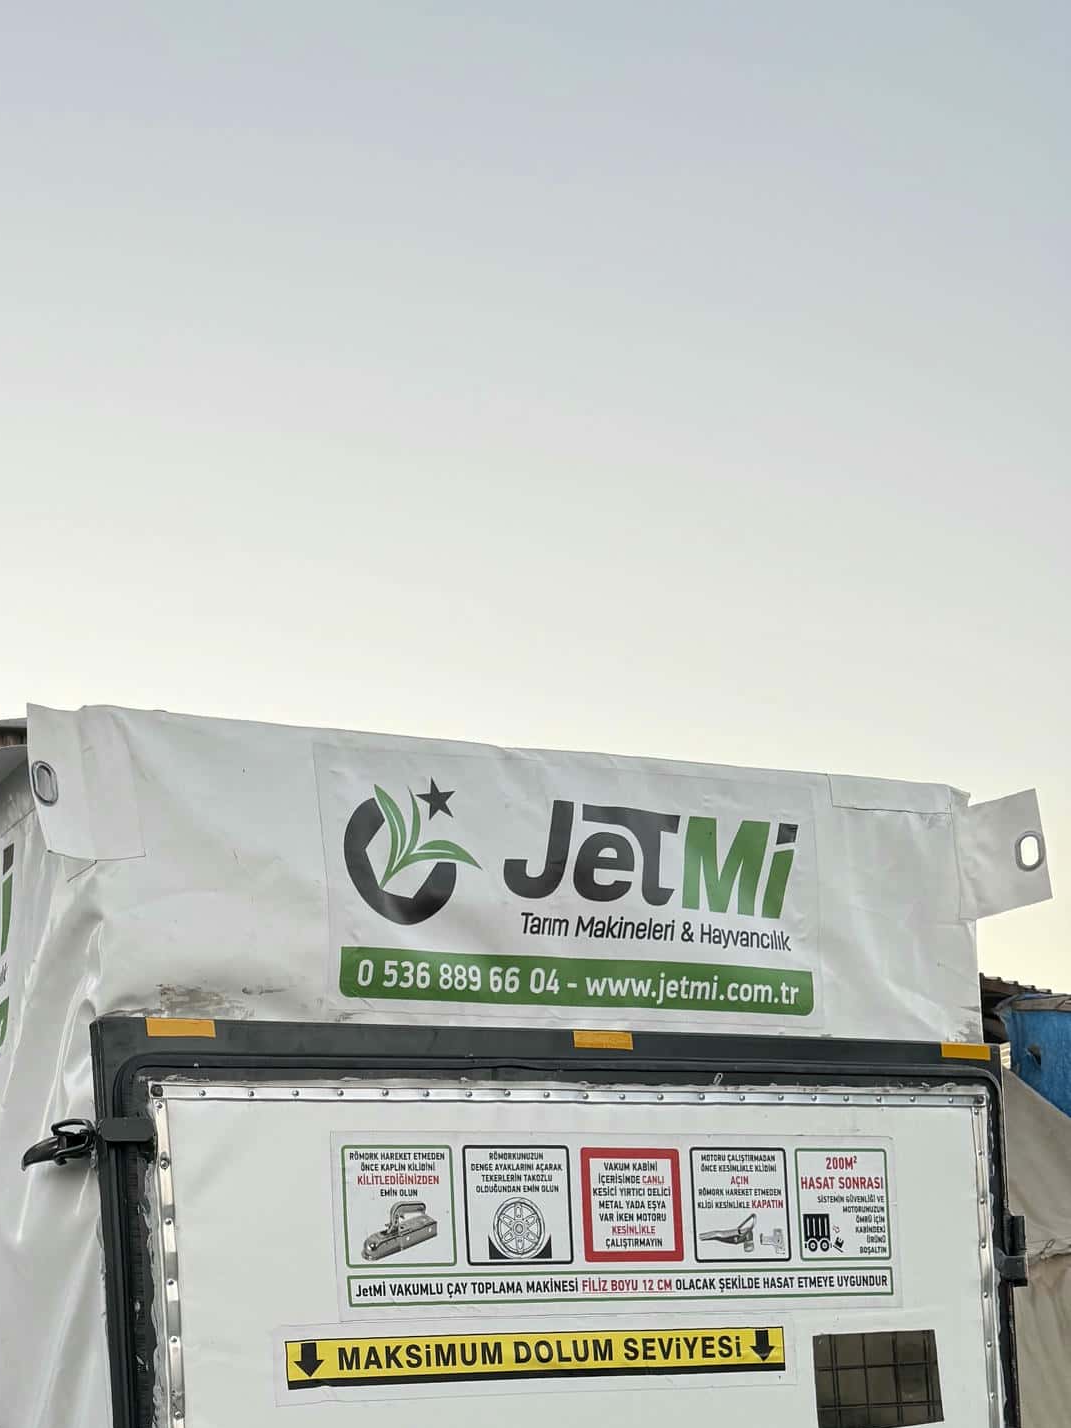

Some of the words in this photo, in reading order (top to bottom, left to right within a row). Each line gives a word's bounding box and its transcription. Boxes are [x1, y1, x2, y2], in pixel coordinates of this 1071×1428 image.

[521, 913, 568, 936] Tarım
[576, 915, 674, 942] Makineleri
[681, 923, 693, 942] &
[701, 924, 791, 950] Hayvancılık
[358, 960, 373, 986] 0
[383, 960, 430, 988] 536
[439, 963, 481, 991] 889
[490, 966, 519, 992] 66
[530, 967, 560, 995] 04
[586, 973, 798, 1005] www.jetmi.com.tr
[349, 1151, 378, 1160] RÖMORK
[361, 1162, 378, 1171] ÖNCE
[381, 1163, 405, 1171] KAPLİN
[536, 1164, 562, 1172] AÇARAK
[604, 1162, 630, 1171] VAKUM
[633, 1161, 657, 1171] KABİNİ
[701, 1163, 717, 1172] ÖNCE
[357, 1173, 439, 1185] KİLİTLEDİĞİNİZDEN
[598, 1173, 640, 1185] İÇERİSİNDE
[642, 1176, 664, 1184] CANLI
[731, 1176, 748, 1187] AÇIN
[801, 1177, 834, 1189] HASAT
[839, 1177, 883, 1189] SONRASI
[380, 1187, 397, 1196] EMİN
[593, 1186, 617, 1196] KESİCİ
[619, 1188, 645, 1196] YIRTICI
[648, 1186, 670, 1196] DELİCİ
[698, 1188, 724, 1196] RÖMORK
[648, 1201, 665, 1211] EŞYA
[752, 1200, 783, 1208] KAPATIN
[599, 1213, 614, 1221] VAR
[636, 1213, 666, 1221] MOTORU
[612, 1224, 656, 1234] KESİNLİKLE
[606, 1239, 662, 1249] ÇALIŞTIRMAYIN
[389, 1283, 443, 1296] VAKUMLU
[447, 1282, 468, 1298] ÇAY
[471, 1281, 523, 1294] TOPLAMA
[527, 1277, 578, 1294] MAKİNESİ
[582, 1276, 608, 1293] FİLİZ
[611, 1279, 638, 1291] BOYU
[643, 1279, 653, 1291] 12
[657, 1279, 672, 1291] CM
[676, 1278, 715, 1290] OLACAK
[719, 1274, 760, 1292] ŞEKİLDE
[764, 1276, 794, 1288] HASAT
[797, 1275, 834, 1287] ETMEYE
[837, 1275, 887, 1287] UYGUNDUR
[514, 1339, 611, 1363] DOLUM
